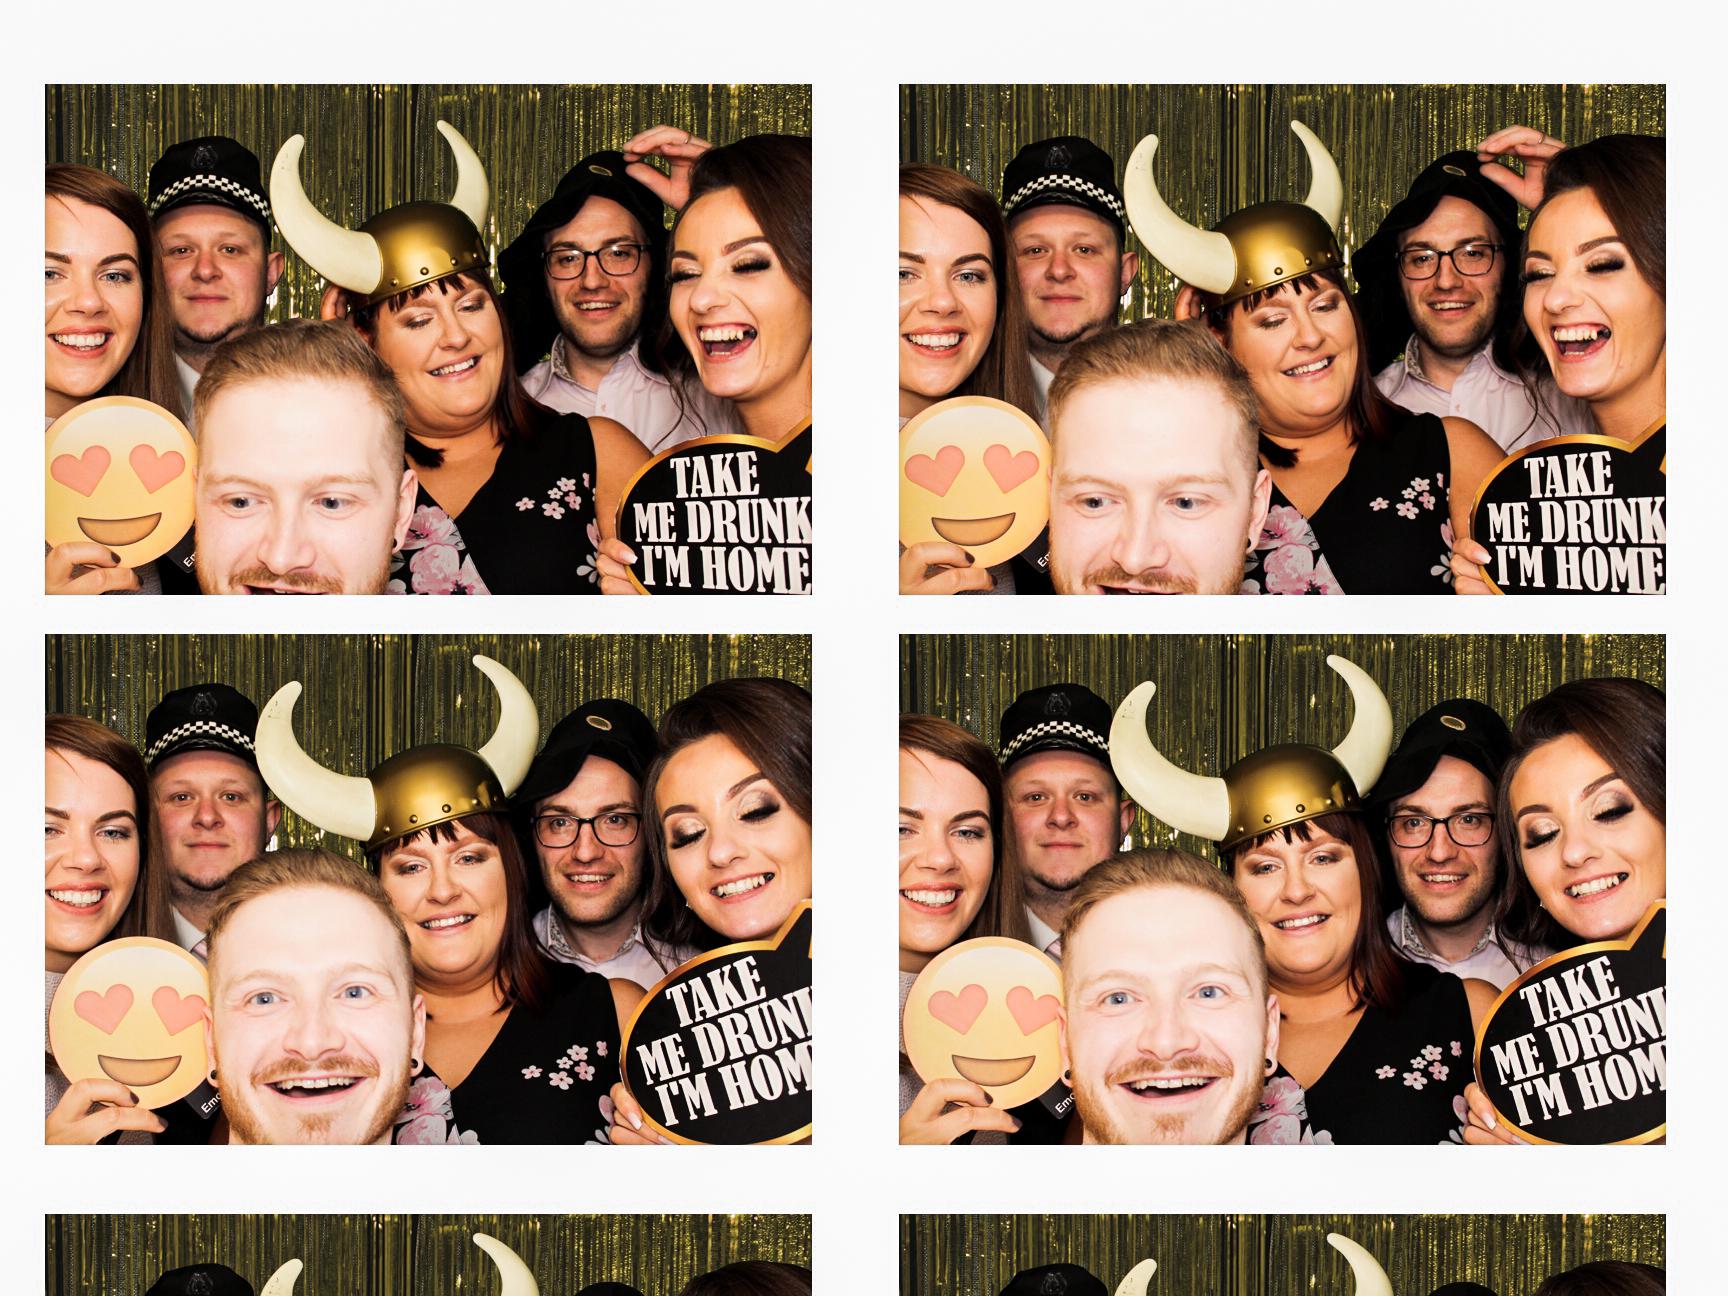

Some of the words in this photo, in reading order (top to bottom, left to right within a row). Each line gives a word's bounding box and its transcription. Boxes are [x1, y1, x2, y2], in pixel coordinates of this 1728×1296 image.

[669, 450, 760, 499] TAKE
[1523, 450, 1614, 499] TAKE
[633, 502, 677, 543] ME
[685, 496, 812, 544] DRUNK
[1487, 502, 1531, 543] ME
[1539, 496, 1666, 544] DRUNK
[641, 545, 692, 588] I'M
[700, 545, 812, 595] HOME
[1495, 545, 1546, 588] I'M
[1554, 545, 1666, 595] HOME
[665, 955, 767, 1028] TAKE
[1519, 955, 1621, 1028] TAKE
[636, 1033, 691, 1086] ME
[691, 985, 812, 1069] DRUN
[1490, 1033, 1545, 1086] ME
[1545, 985, 1666, 1069] DRUN
[655, 1072, 718, 1127] I'M
[1509, 1072, 1572, 1127] I'M
